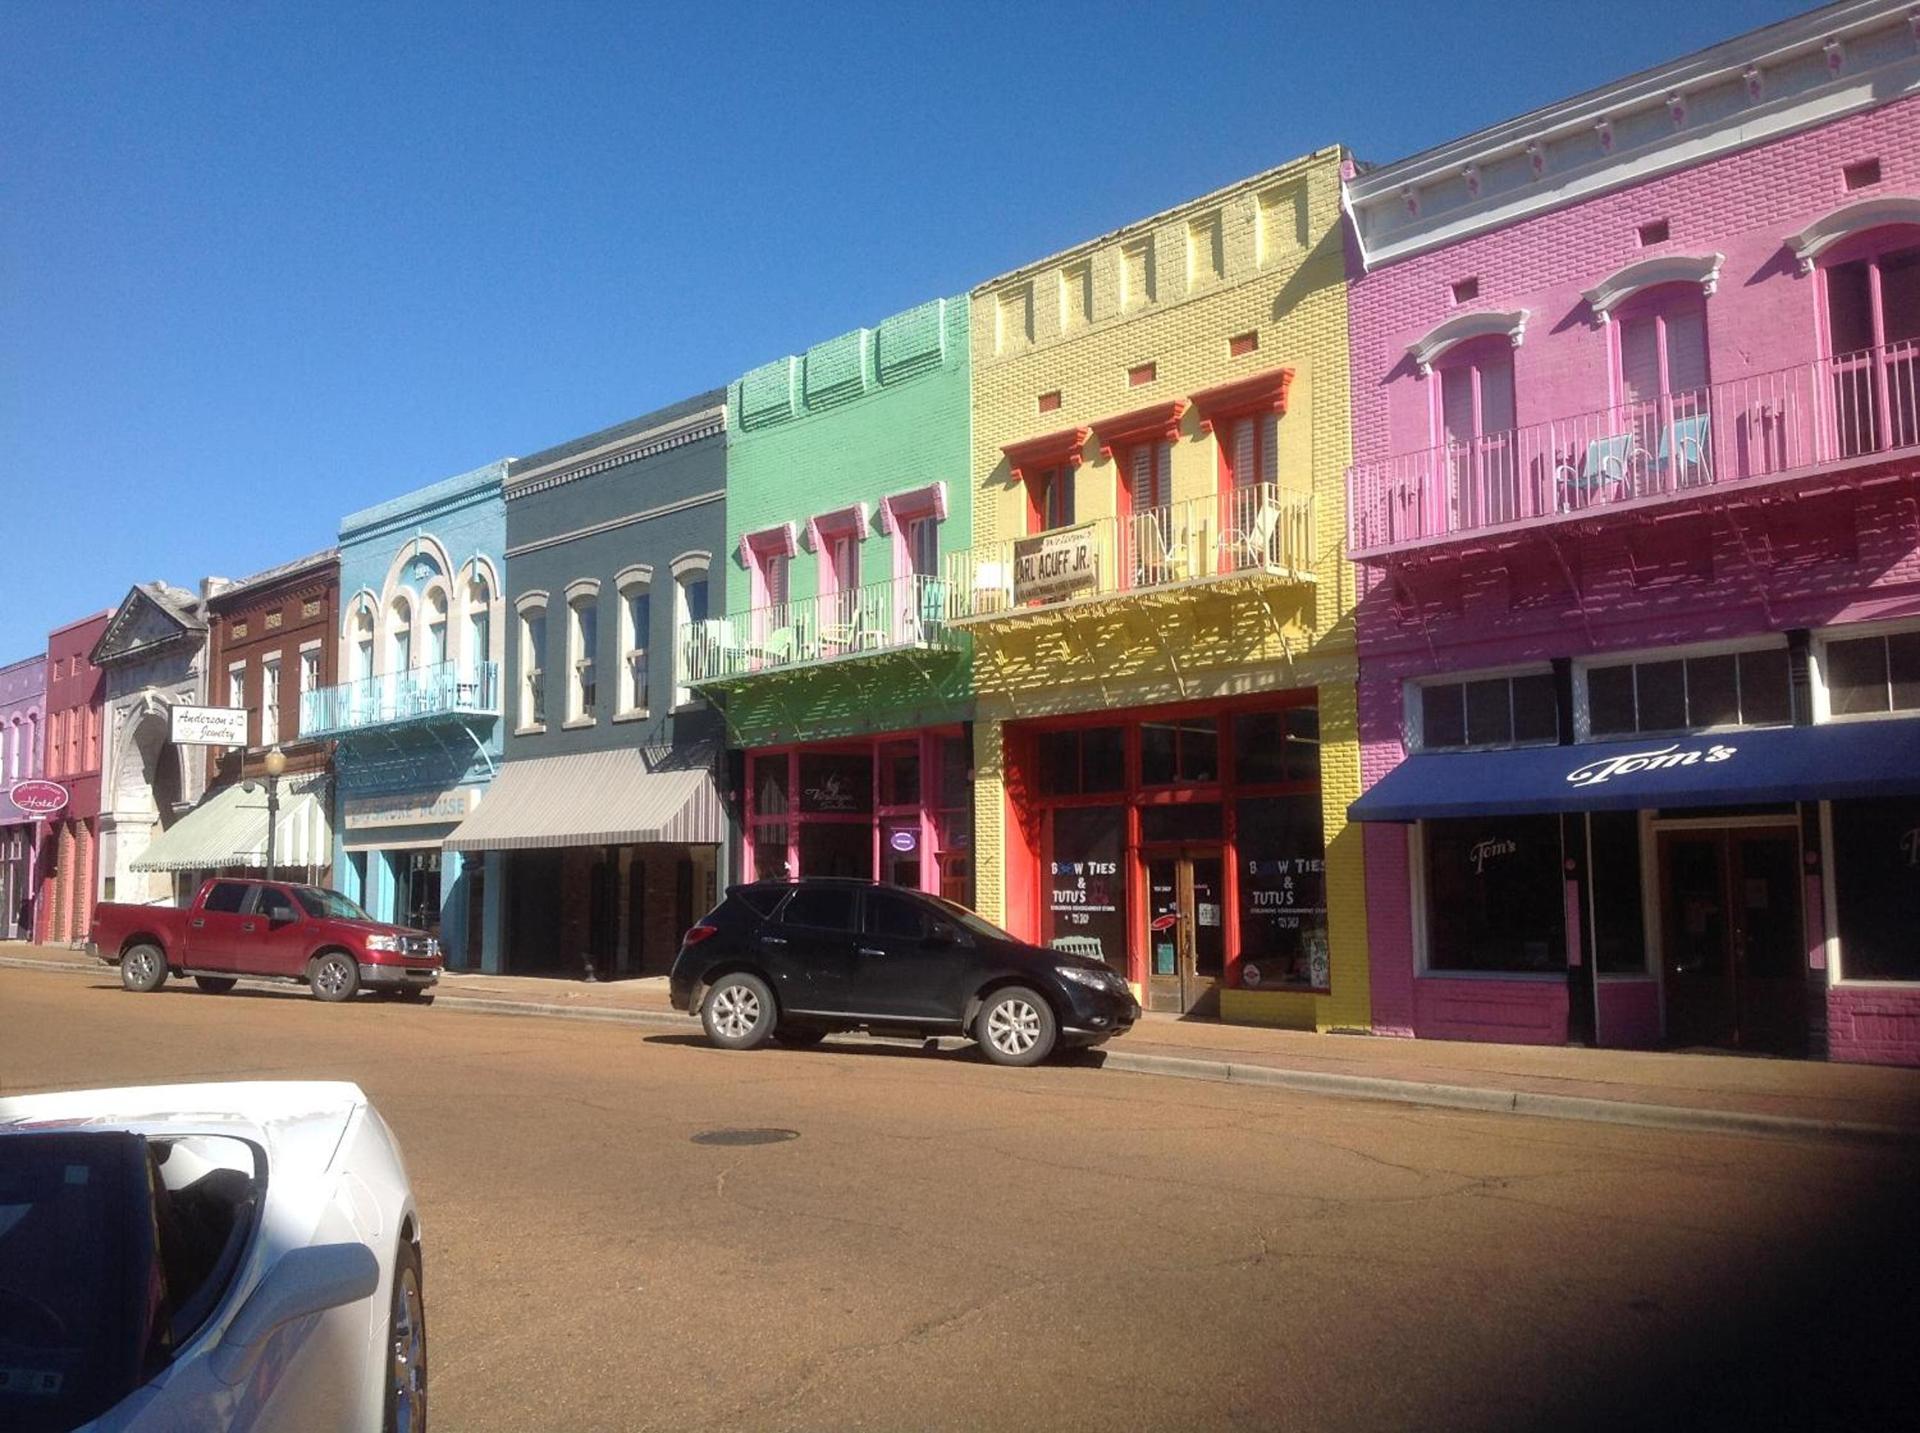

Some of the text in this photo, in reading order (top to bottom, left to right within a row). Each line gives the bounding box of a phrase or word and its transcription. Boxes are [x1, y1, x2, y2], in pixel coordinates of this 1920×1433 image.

[1039, 549, 1071, 580] ACUFF
[1072, 545, 1090, 572] JR.
[199, 725, 235, 741] Jewelry
[1566, 743, 1738, 788] Tom's
[19, 796, 61, 808] Hotel
[1470, 836, 1517, 875] Tom's
[1087, 861, 1117, 875] TIES
[1249, 860, 1289, 874] BW
[1077, 876, 1087, 890] &
[1283, 875, 1294, 890] &
[1252, 890, 1295, 905] TUTUS
